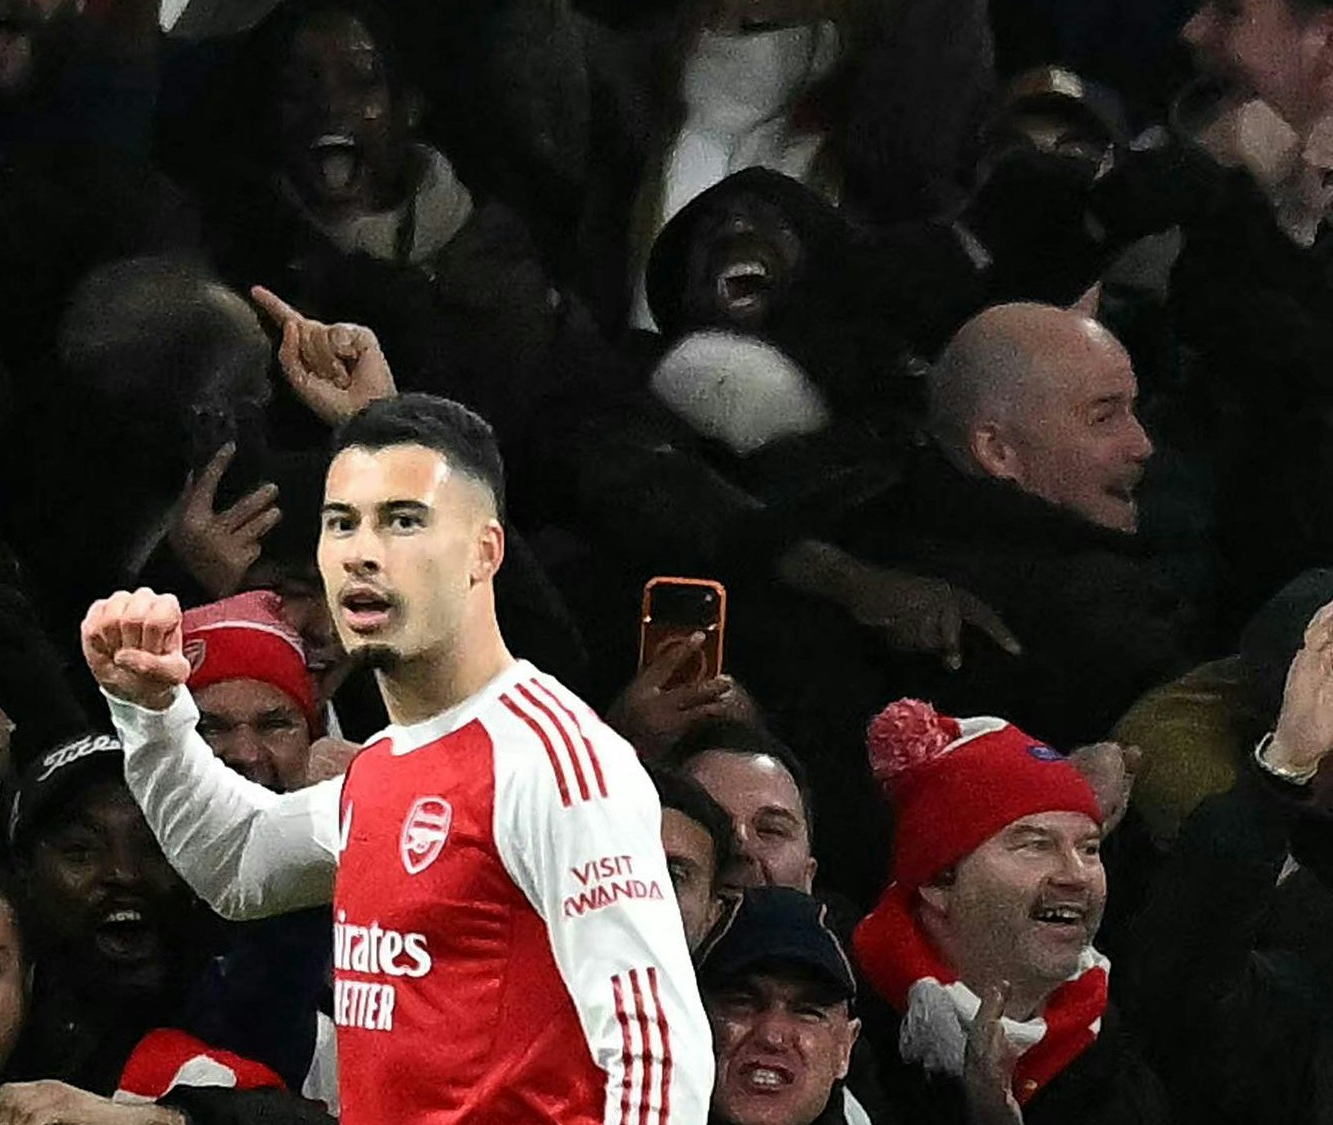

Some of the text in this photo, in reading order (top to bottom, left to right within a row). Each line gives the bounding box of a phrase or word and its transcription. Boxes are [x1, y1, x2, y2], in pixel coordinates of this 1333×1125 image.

[37, 735, 122, 782] Title
[571, 855, 633, 885] VISIT
[334, 909, 432, 978] irates
